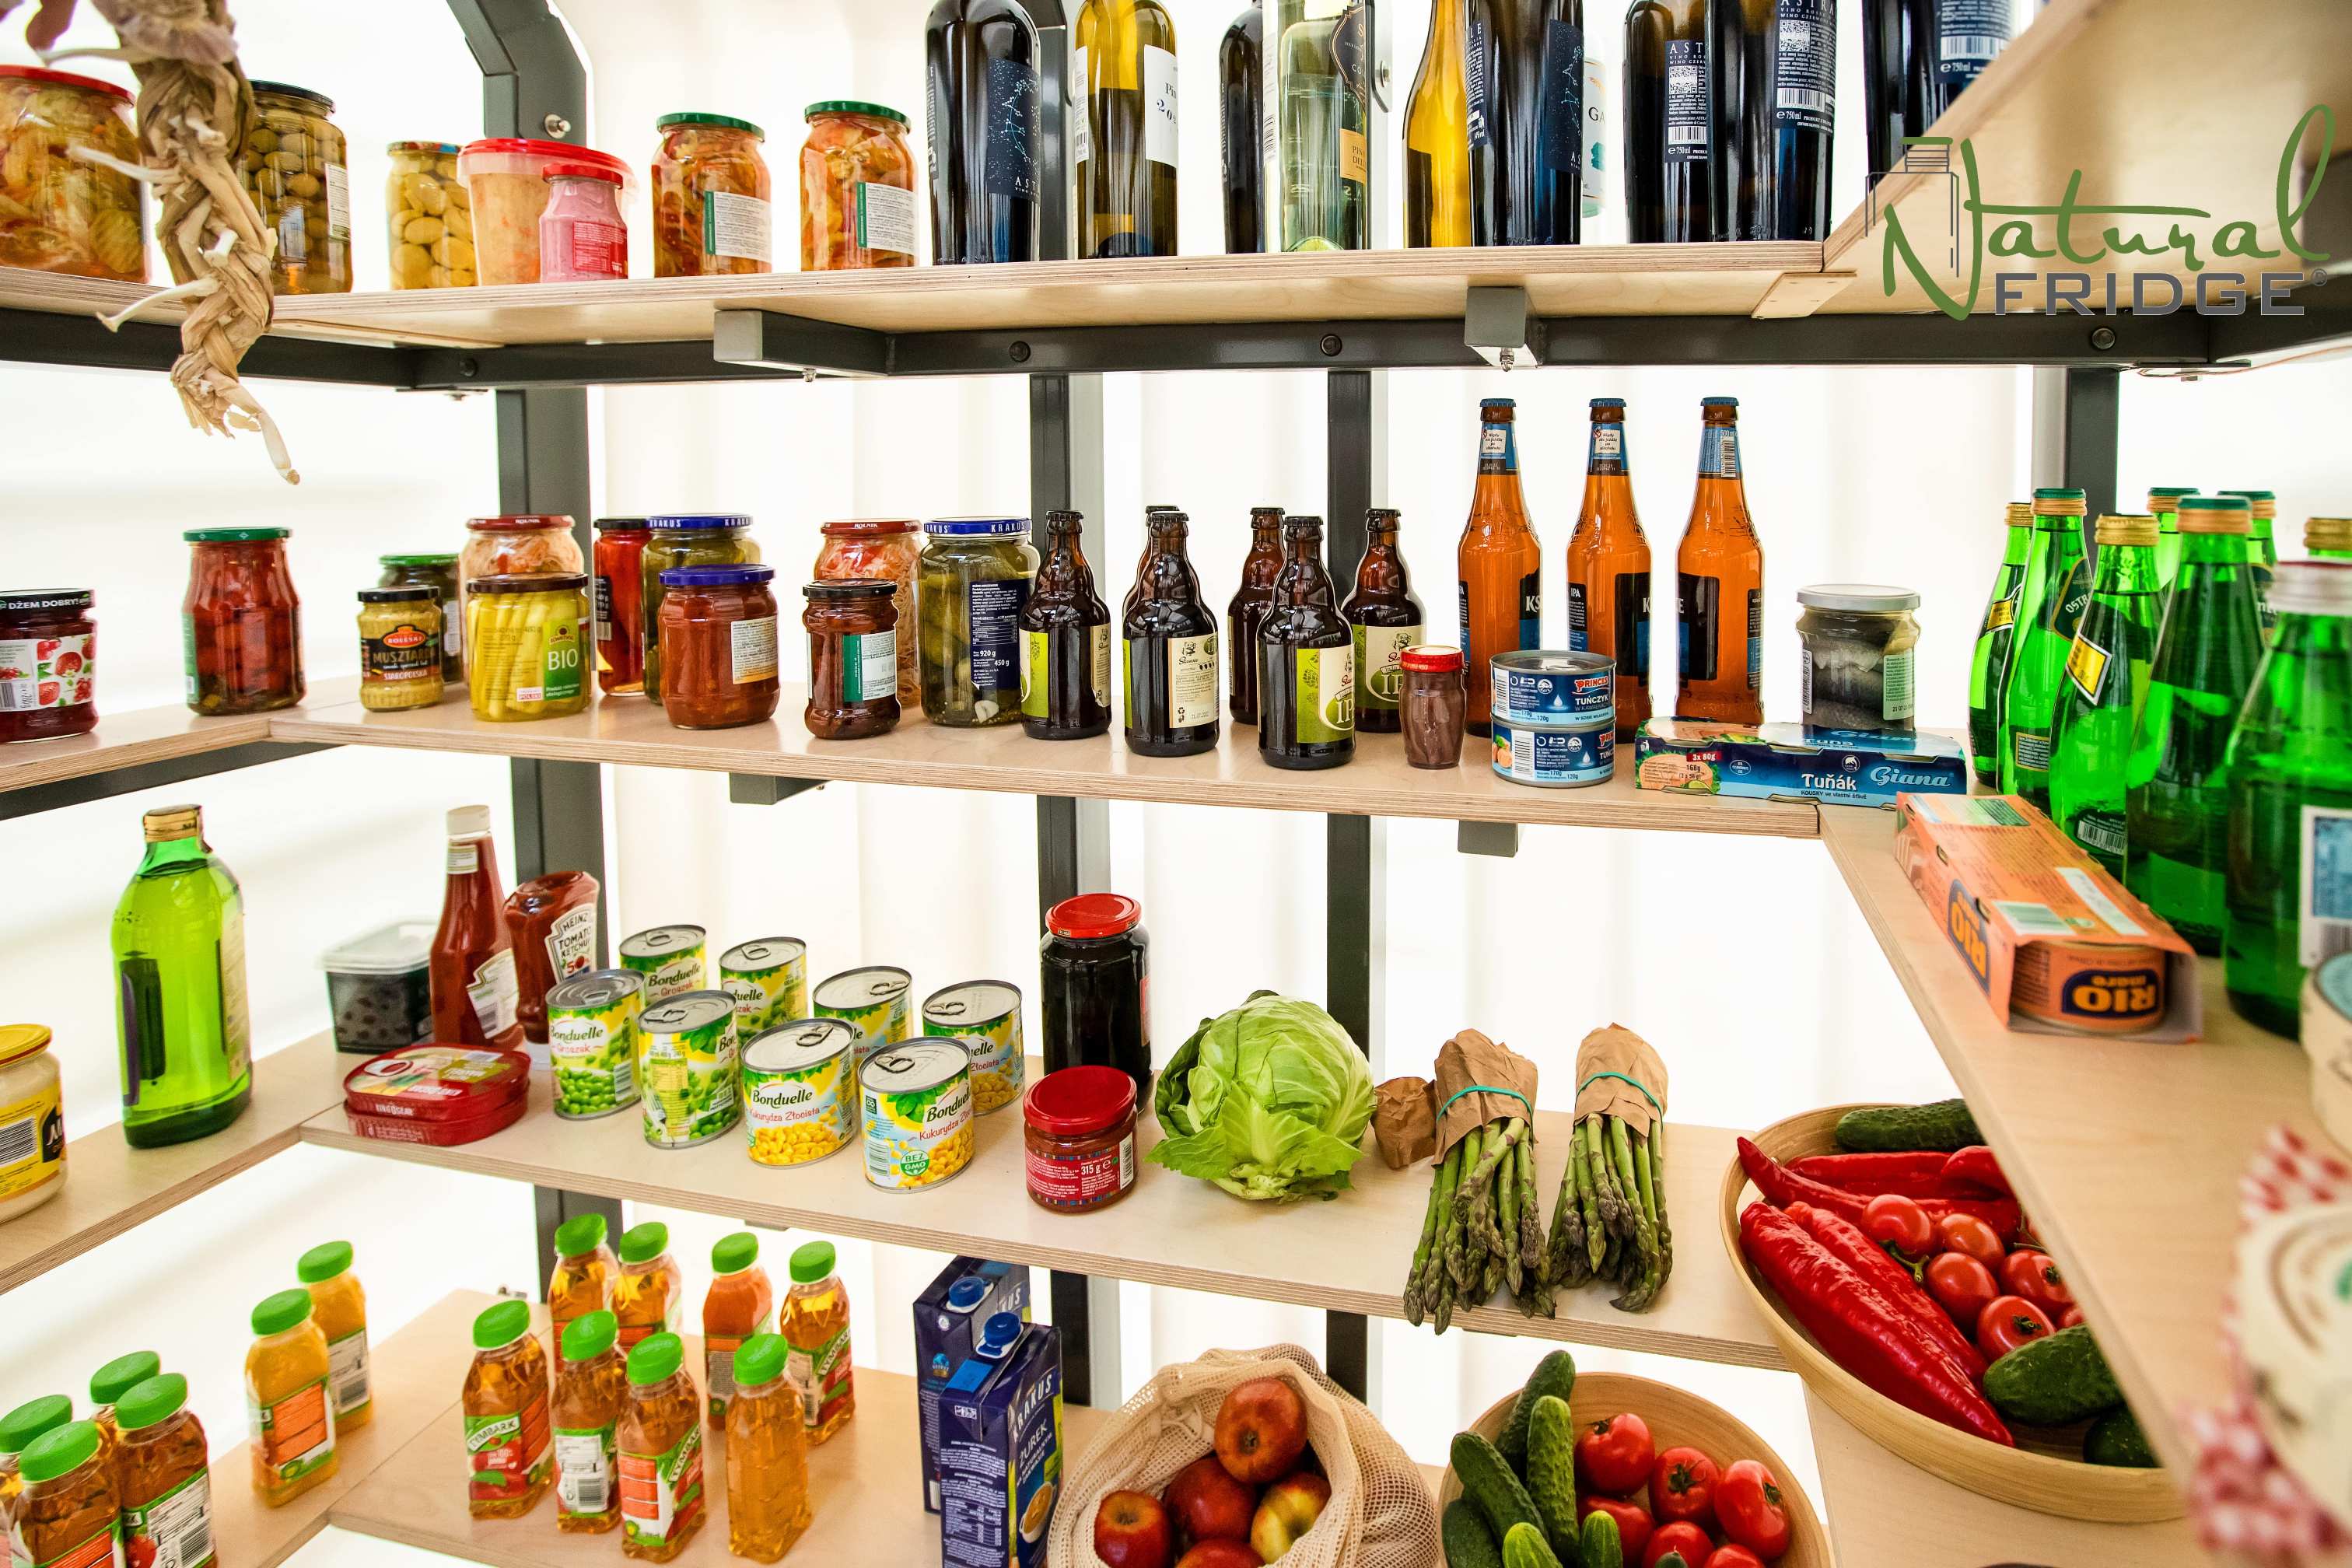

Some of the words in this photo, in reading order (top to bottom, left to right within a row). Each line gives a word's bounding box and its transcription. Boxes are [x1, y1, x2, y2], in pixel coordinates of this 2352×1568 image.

[1787, 111, 1801, 120] 750ml
[1676, 146, 1691, 155] 750ml
[991, 522, 1025, 534] KRAKUS
[1570, 587, 1581, 598] IPA
[9, 600, 40, 610] DŻEM
[42, 598, 79, 608] DOBRY!
[548, 648, 579, 670] BIO
[1573, 676, 1608, 692] PRINCES
[1575, 695, 1608, 705] TUŃCZYK
[1703, 753, 1716, 761] 80g
[1801, 772, 1857, 792] Tuňák
[1870, 766, 1953, 788] Giana
[562, 912, 588, 931] HEINZ
[648, 963, 701, 987] Bonduelle
[2073, 984, 2156, 1013] RIO
[551, 1025, 604, 1044] Bonduelle
[753, 1089, 813, 1109] Bonduelle
[785, 1108, 821, 1121] Złocista
[919, 1119, 959, 1141] Kukurydza
[905, 1153, 924, 1162] BEZ
[905, 1161, 926, 1170] GMO
[1081, 1164, 1094, 1175] 315
[1095, 1165, 1101, 1174] g
[1013, 1373, 1052, 1444] KRAKUS
[1019, 1417, 1048, 1469] ŻUREK
